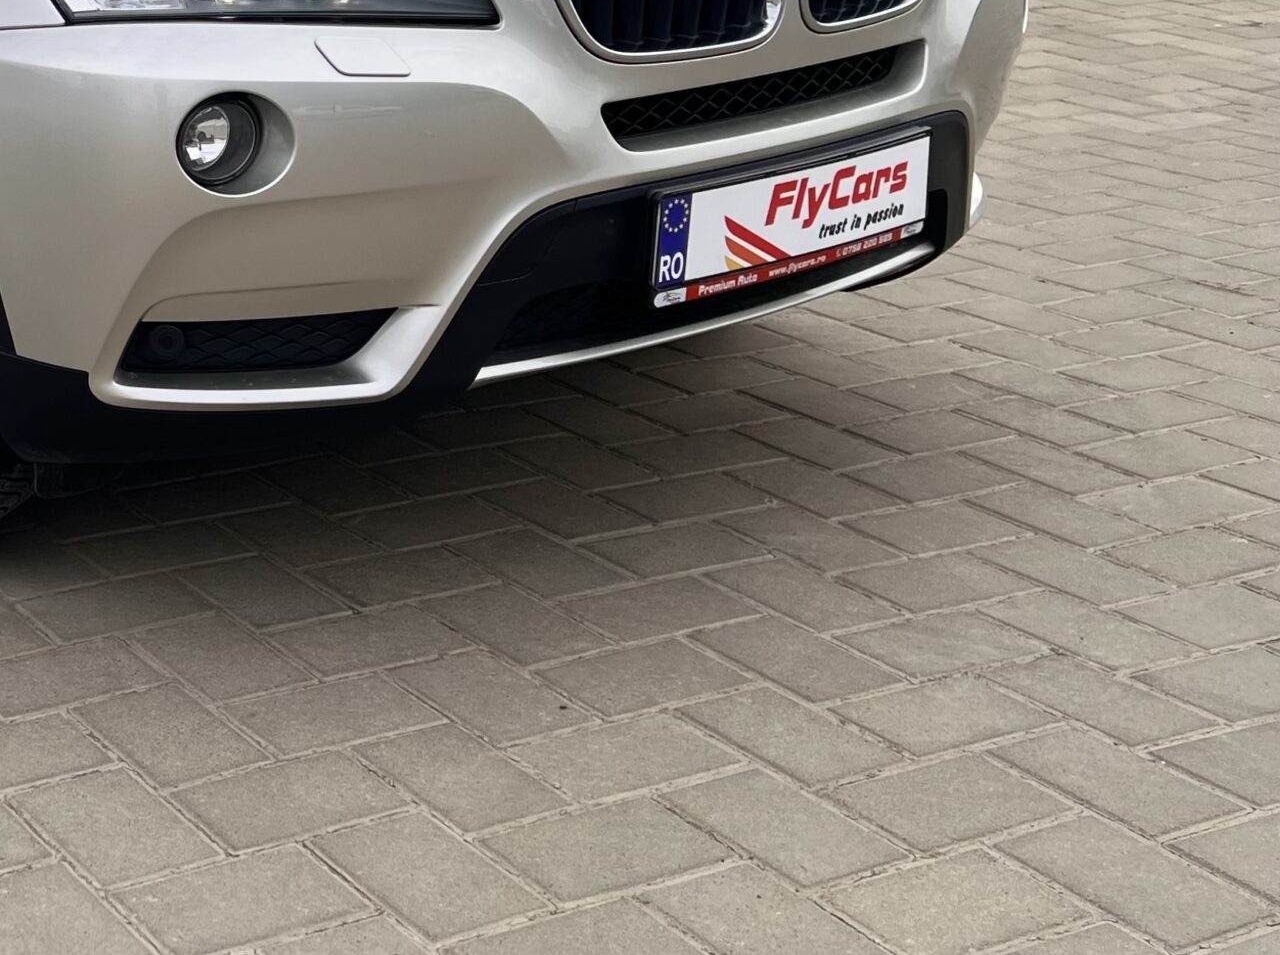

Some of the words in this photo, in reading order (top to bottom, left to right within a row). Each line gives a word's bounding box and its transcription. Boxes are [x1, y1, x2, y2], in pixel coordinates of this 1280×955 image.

[765, 161, 908, 229] FlyCars
[819, 217, 848, 239] trust
[850, 213, 862, 231] in
[863, 202, 904, 231] passion
[659, 252, 683, 283] RO
[698, 279, 736, 296] Premium
[737, 273, 758, 286] Auto
